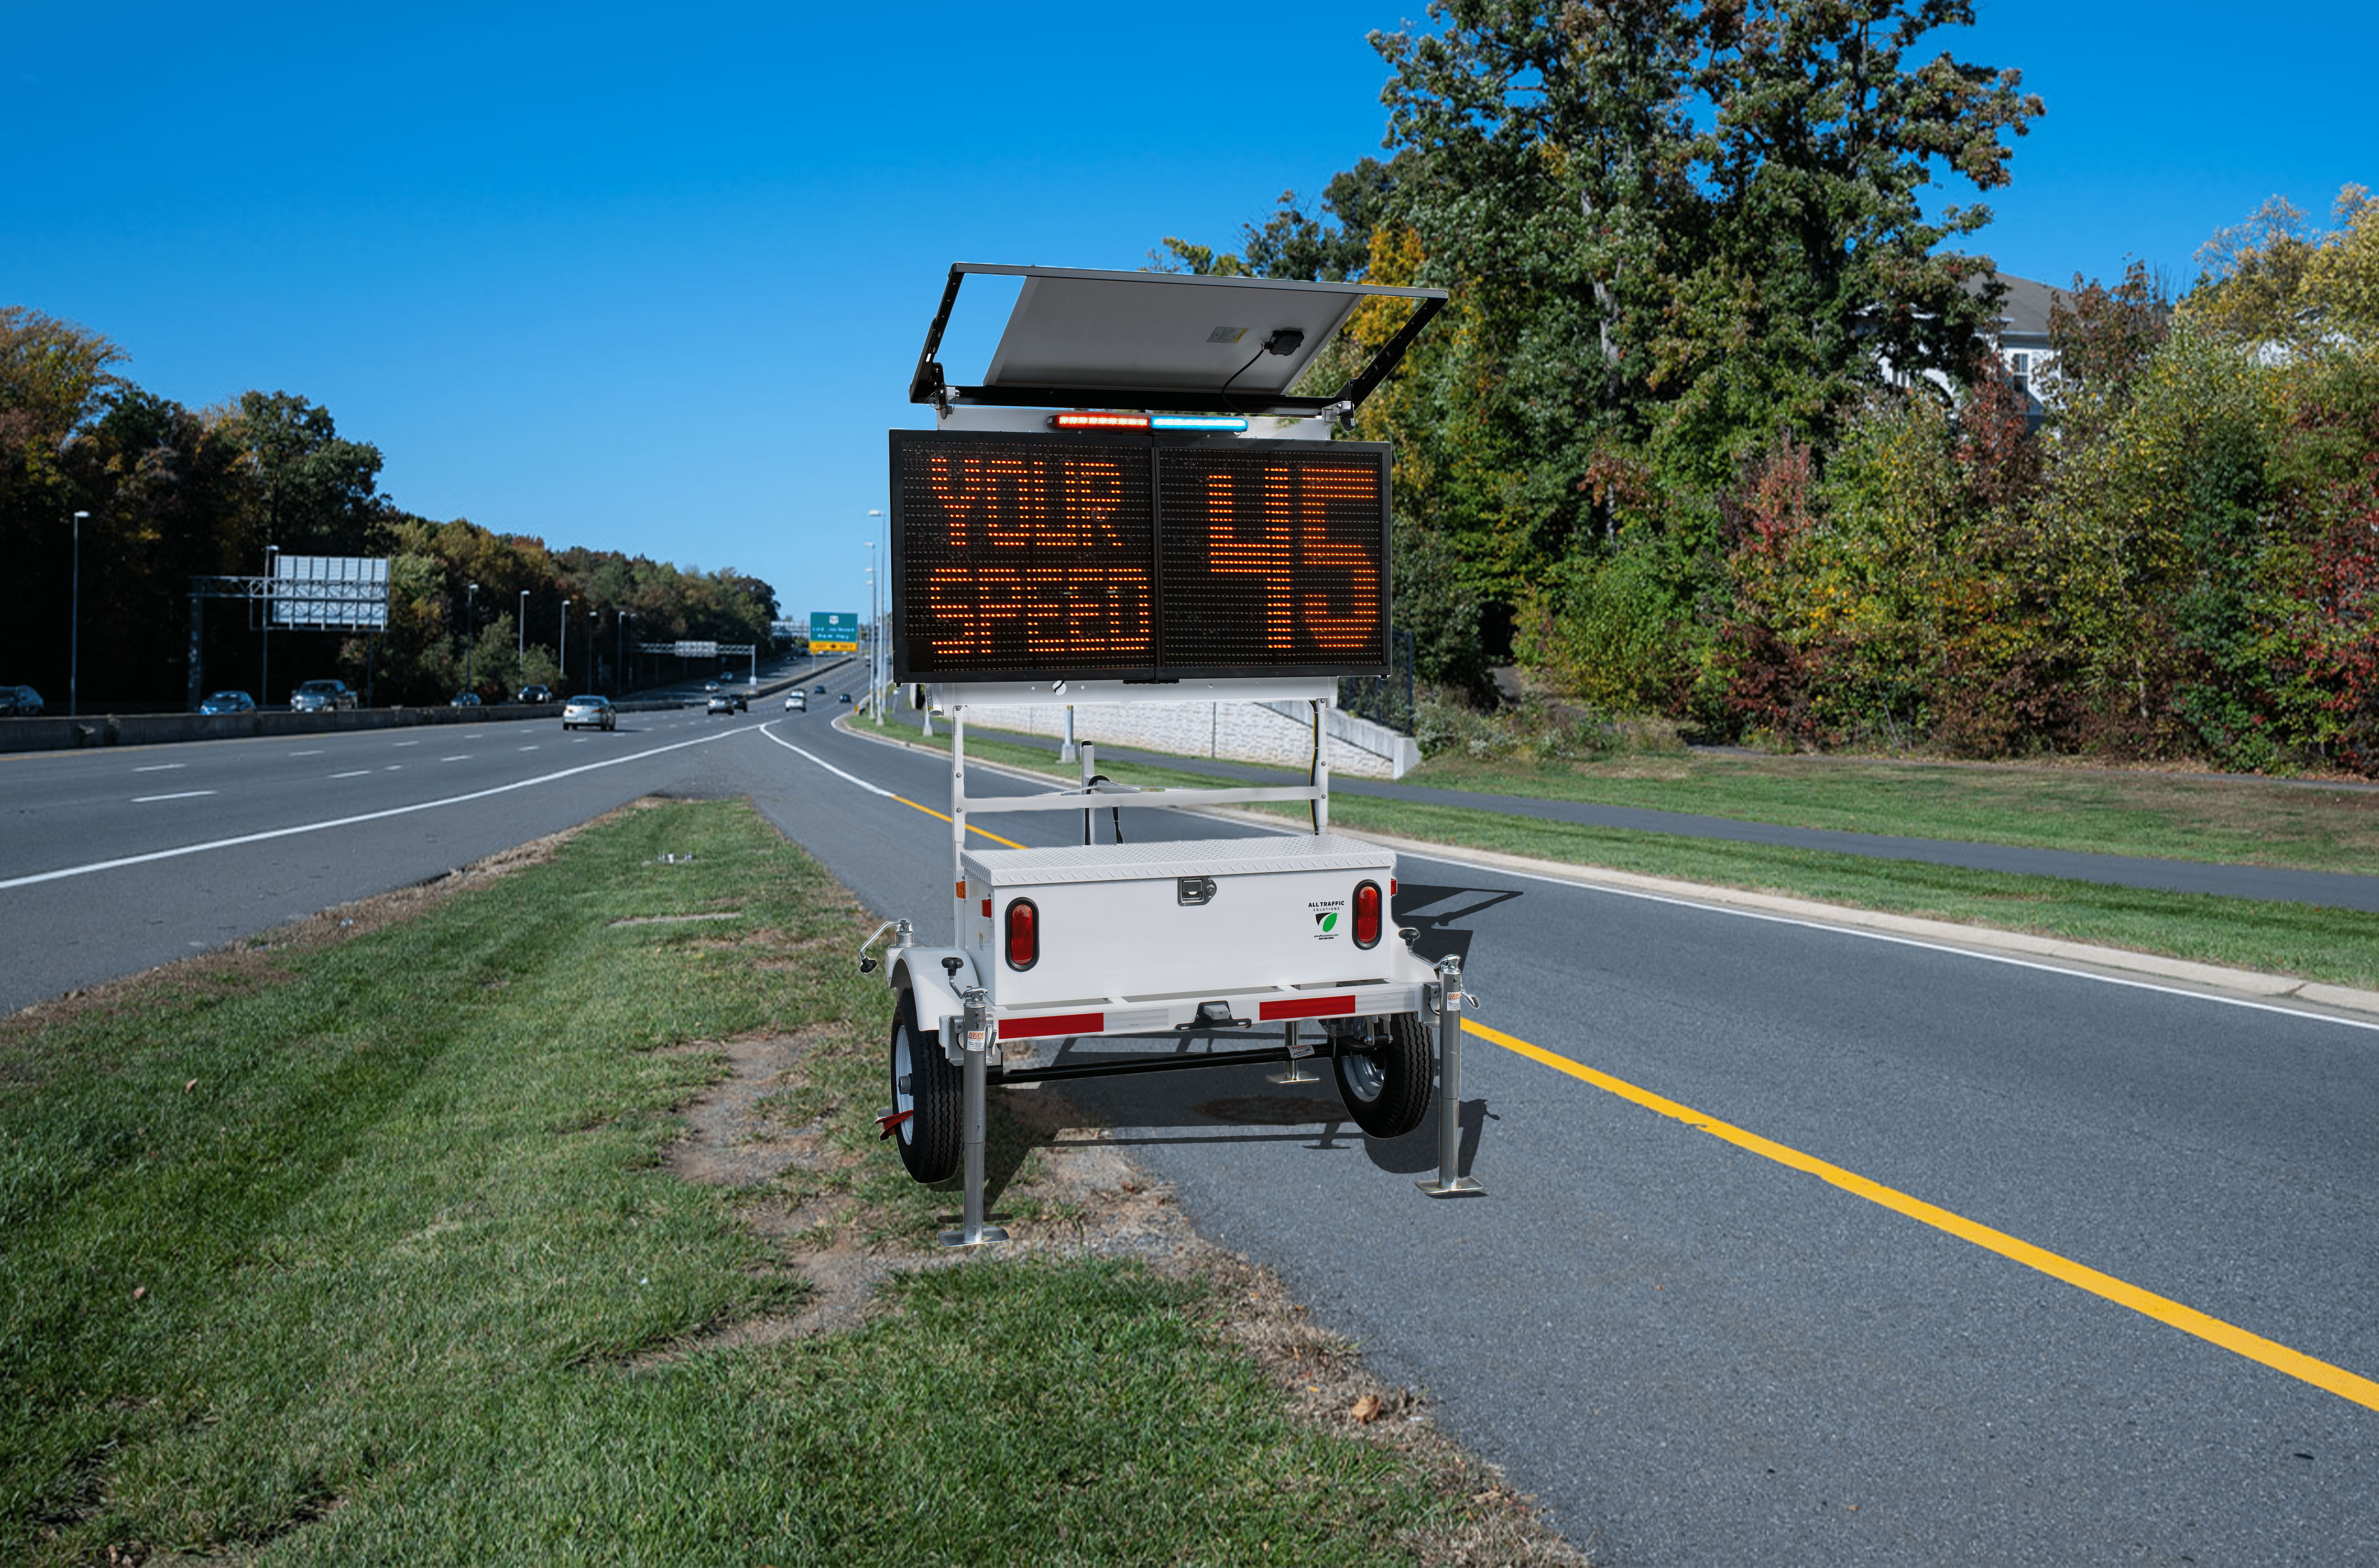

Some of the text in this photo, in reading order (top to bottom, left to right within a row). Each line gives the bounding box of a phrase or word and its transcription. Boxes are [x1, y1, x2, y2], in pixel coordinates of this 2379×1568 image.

[931, 457, 1123, 546] YOUR
[1208, 467, 1378, 649] 45
[930, 568, 1150, 655] SPEED
